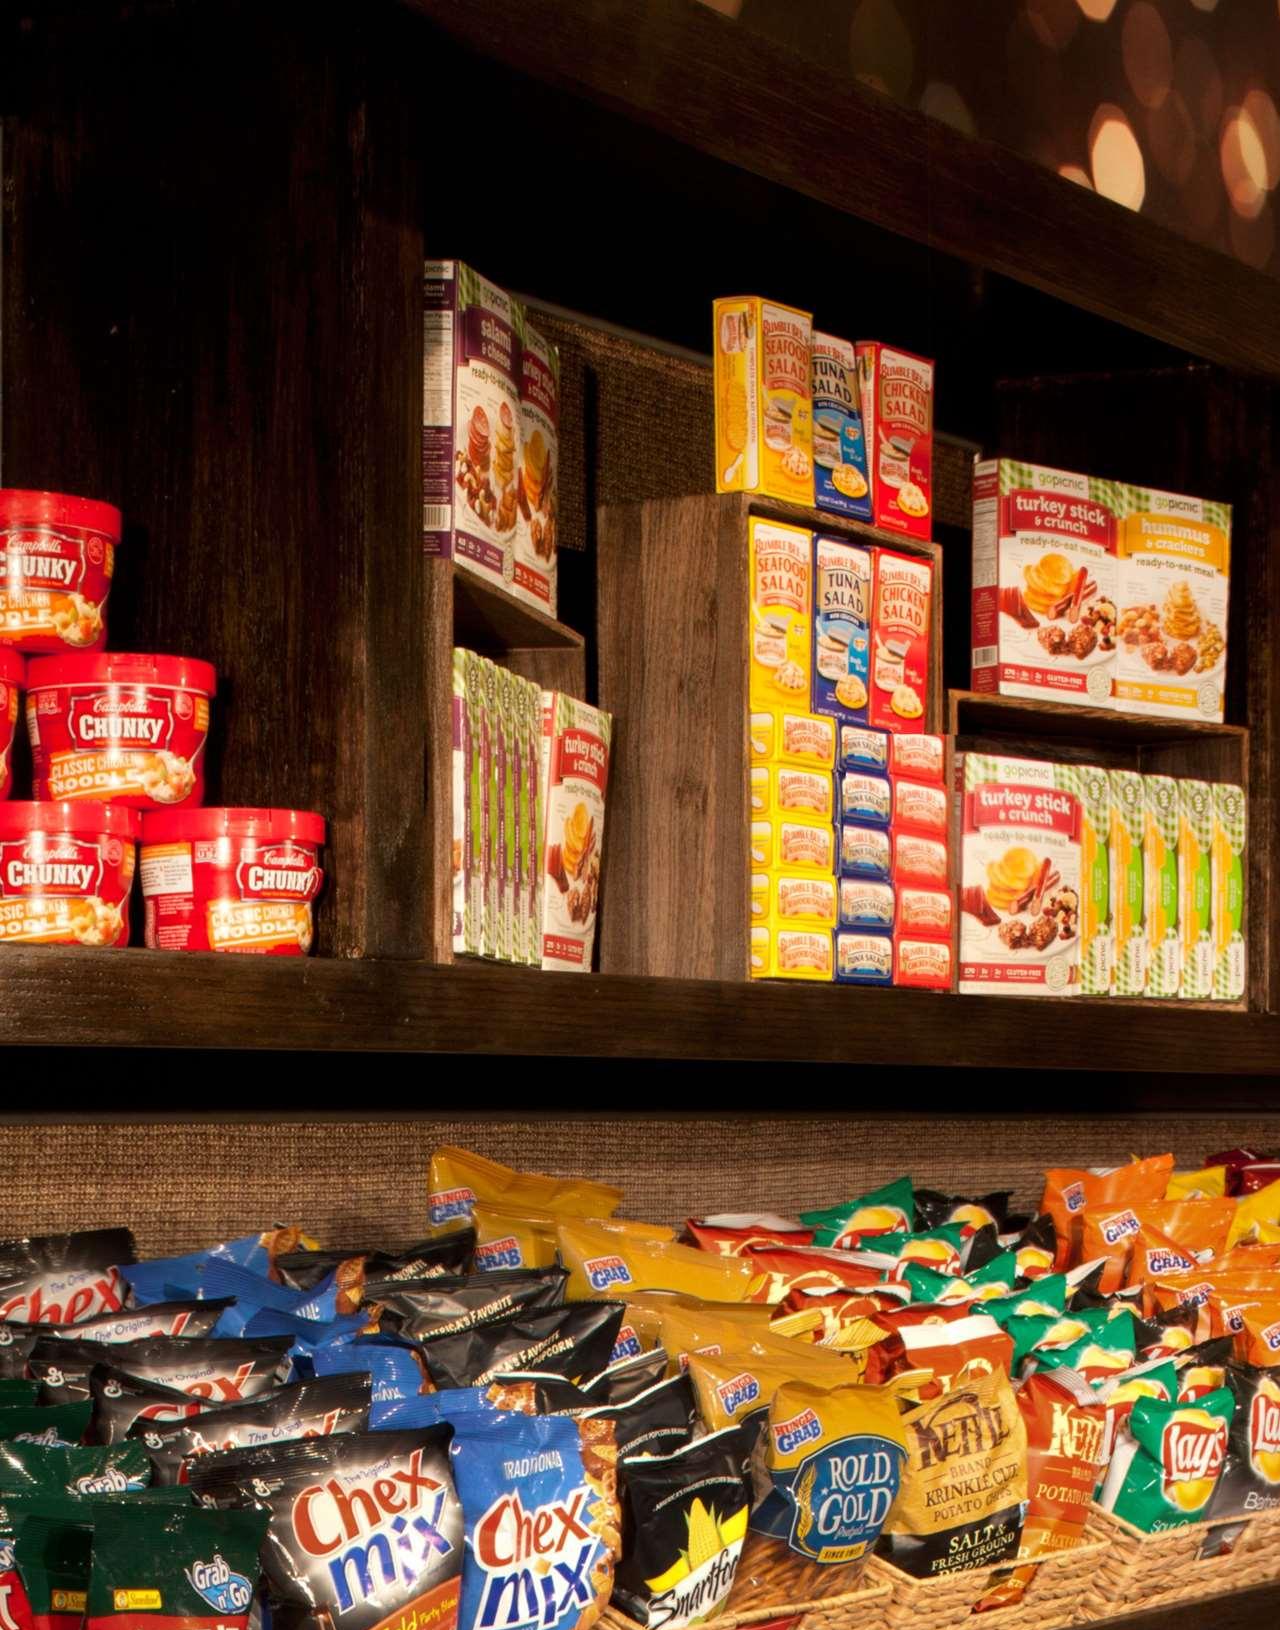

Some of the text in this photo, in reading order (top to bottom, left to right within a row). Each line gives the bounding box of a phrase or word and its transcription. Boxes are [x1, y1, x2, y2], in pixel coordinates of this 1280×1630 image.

[481, 319, 512, 347] salami
[765, 338, 809, 364] SEAFOOD
[767, 360, 807, 384] SALAD
[813, 360, 847, 385] TUNA
[883, 381, 928, 408] CHICKEN
[885, 401, 925, 425] SALAD
[1039, 472, 1084, 490] gopicnic
[1016, 496, 1105, 526] turkey stick
[1155, 496, 1199, 514] gopicnic
[1044, 518, 1088, 535] crunch
[1141, 519, 1210, 545] hummus
[1020, 536, 1079, 552] ready-to-eat
[1156, 538, 1205, 557] crackers
[757, 557, 807, 581] SEAFOOD
[828, 572, 861, 595] TUNA
[824, 590, 864, 614] SALAD
[882, 587, 925, 611] CHICKEN
[79, 714, 165, 741] CHUNKY
[52, 755, 95, 780] CLASSIC
[52, 770, 144, 795] NOODLE
[980, 789, 1070, 815] turkey stick
[1009, 810, 1053, 824] crunch
[8, 861, 96, 887] CHUNKY
[214, 920, 296, 940] NOODLE
[592, 1267, 629, 1289] GRAB
[471, 1296, 513, 1321] FAVORITE
[774, 1410, 816, 1436] HUNGER
[777, 1422, 821, 1451] GRAB
[1165, 1421, 1225, 1482] Lay's
[504, 1451, 562, 1479] TRADITIONAL
[828, 1452, 890, 1489] ROLD
[950, 1457, 991, 1478] BRAND
[925, 1464, 1018, 1507] KRINKLE CUT
[292, 1449, 444, 1556] Chex
[819, 1487, 892, 1534] GOLD
[934, 1500, 981, 1522] POTATO
[475, 1488, 597, 1570] Chex
[949, 1526, 995, 1553] SALT
[329, 1488, 456, 1614] mix
[932, 1550, 970, 1572] FRESH
[971, 1532, 1015, 1559] GROUND
[193, 1555, 229, 1589] Grab
[230, 1582, 251, 1605] Go
